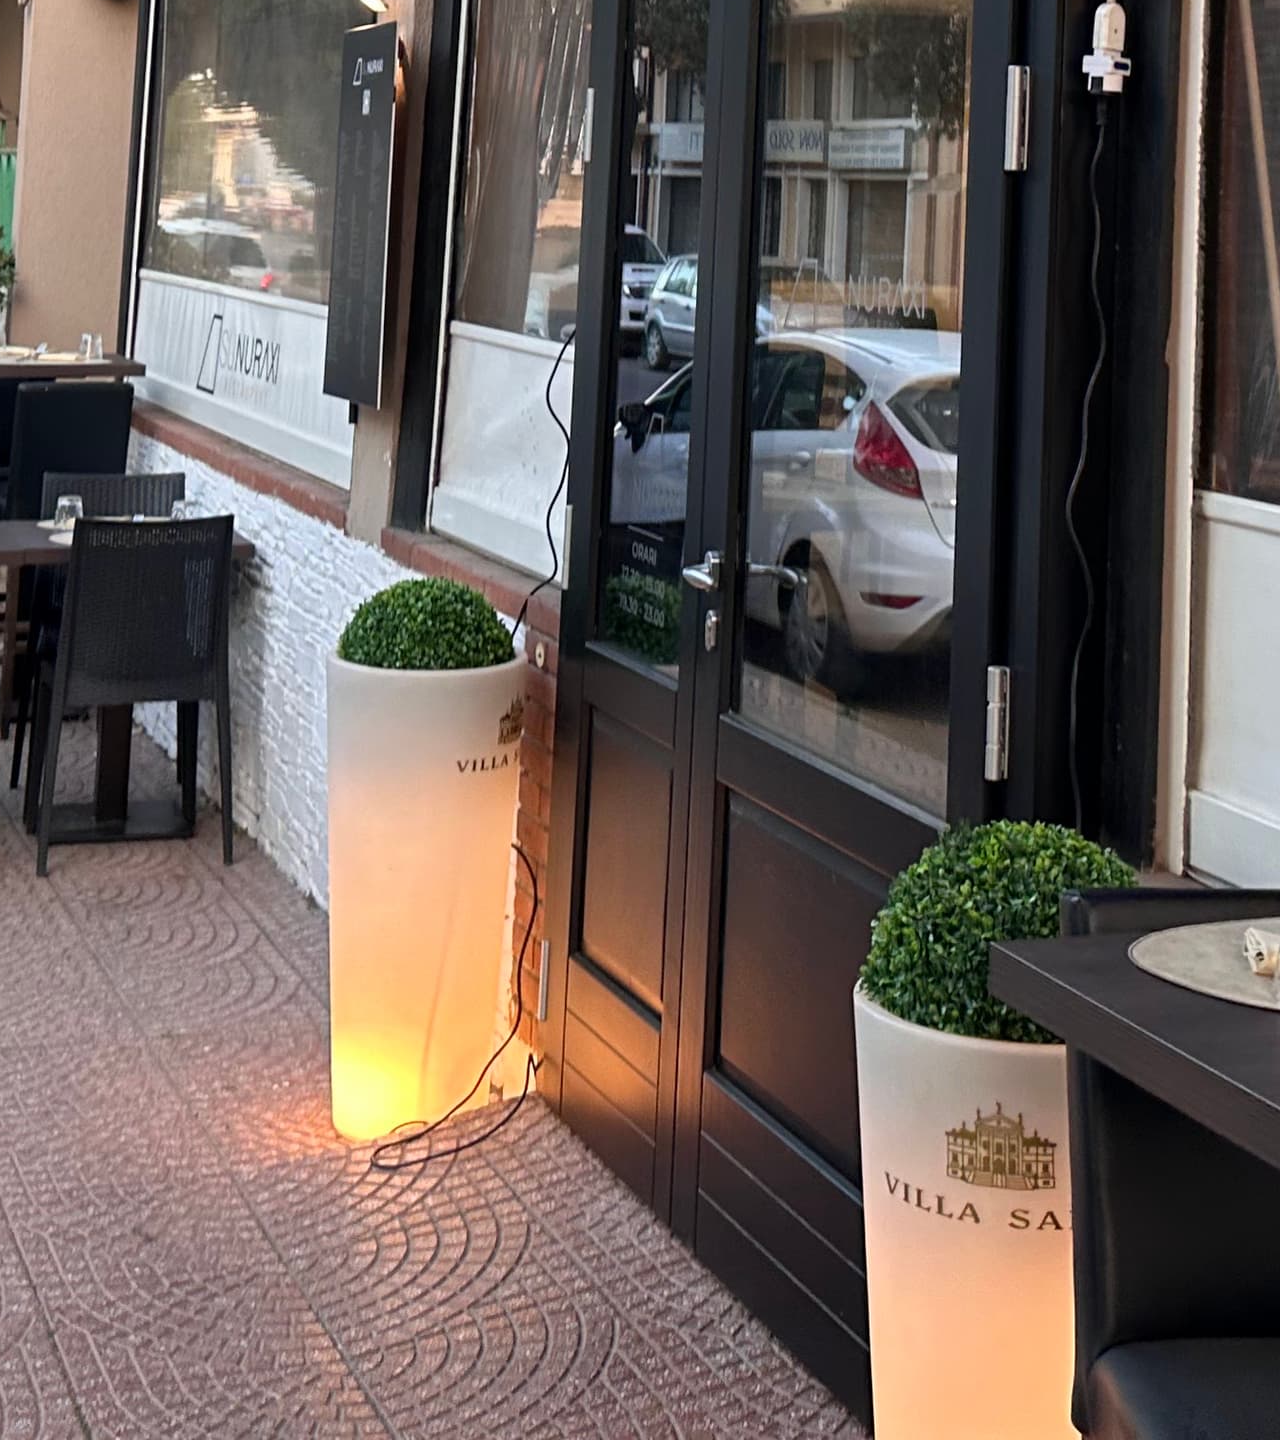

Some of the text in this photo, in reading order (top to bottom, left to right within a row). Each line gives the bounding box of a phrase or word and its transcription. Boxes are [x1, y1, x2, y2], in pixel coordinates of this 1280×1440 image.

[847, 273, 926, 320] NURAXI
[457, 753, 508, 773] VILLA
[884, 1171, 1074, 1231] VILLA SA
